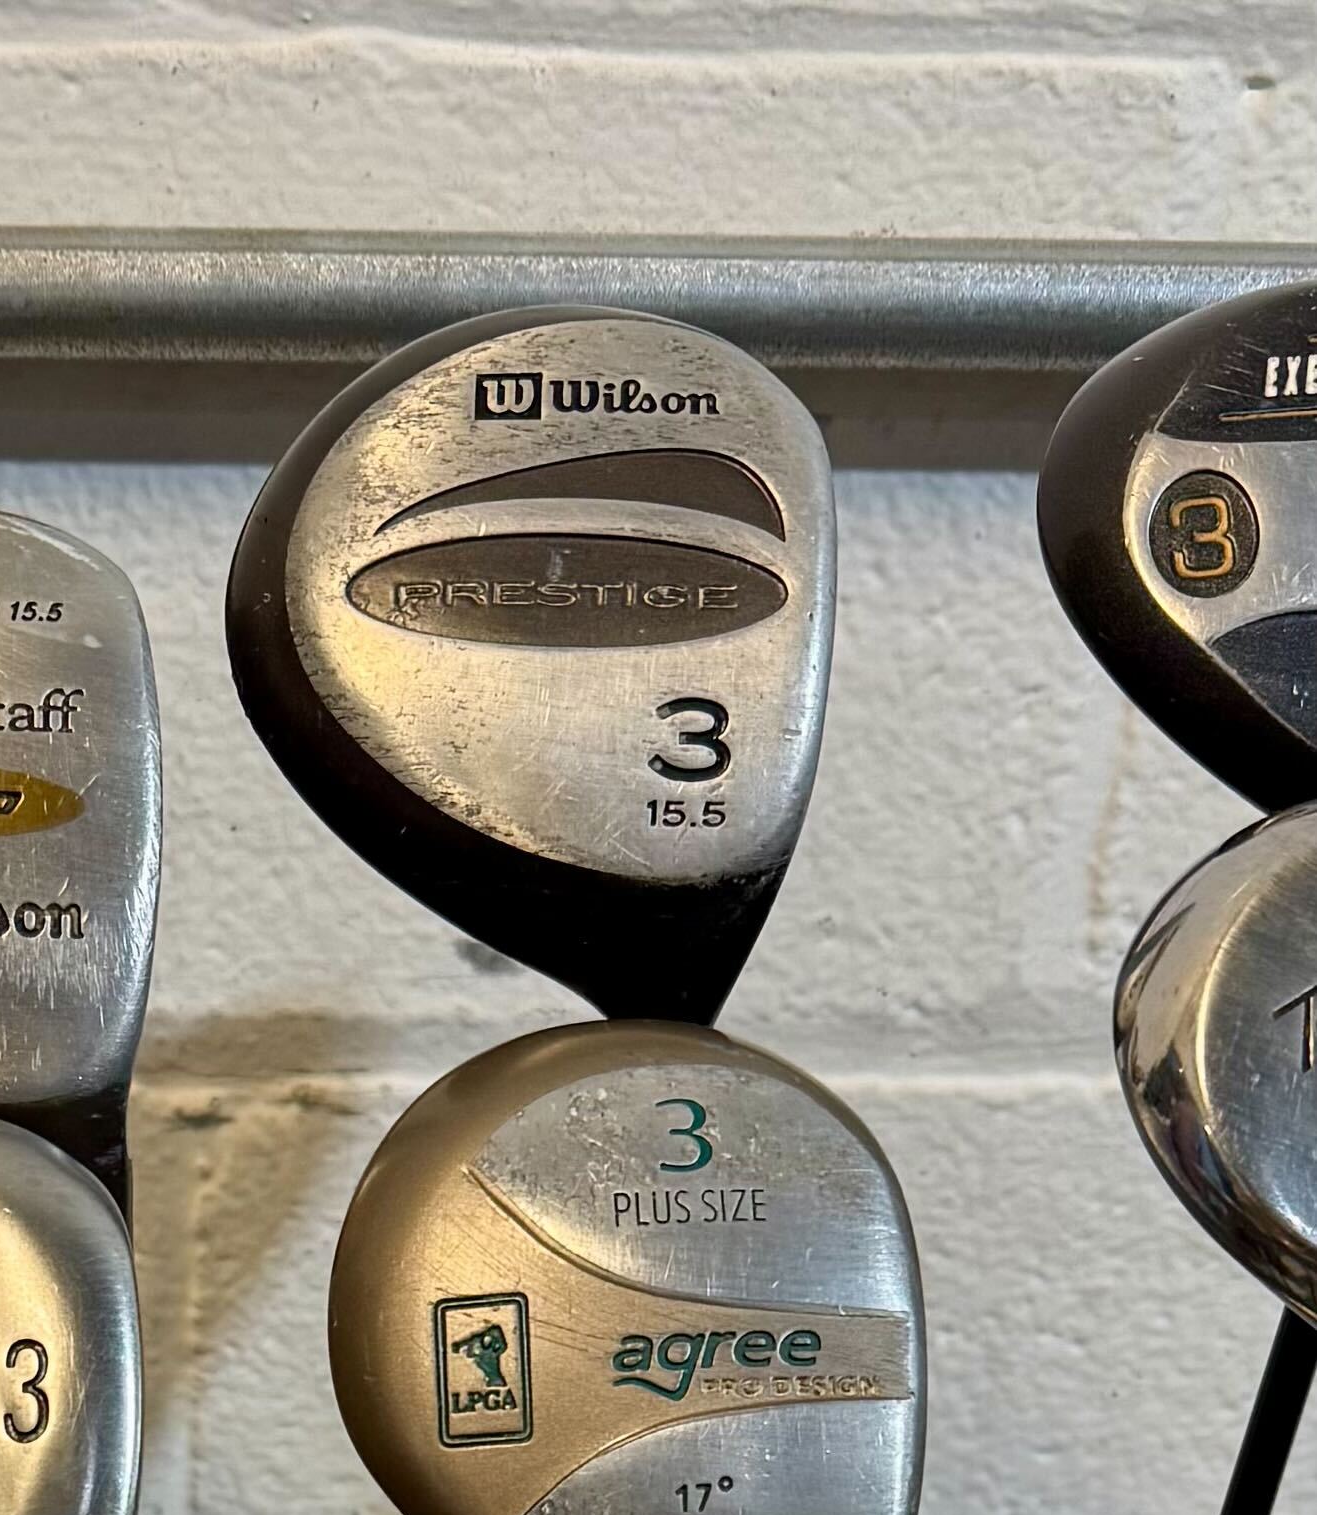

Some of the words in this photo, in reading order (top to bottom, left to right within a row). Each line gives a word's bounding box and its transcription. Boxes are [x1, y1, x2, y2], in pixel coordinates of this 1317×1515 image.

[549, 379, 720, 416] Wilson
[1169, 495, 1235, 579] 3
[9, 601, 63, 623] 15.5
[394, 580, 739, 609] PRESTIGE
[647, 697, 731, 783] 3
[646, 800, 728, 829] 15.5
[655, 1097, 713, 1174] 3
[613, 1191, 691, 1227] PLUS
[703, 1188, 767, 1224] SIZE
[611, 1328, 822, 1401] agree
[3, 1338, 51, 1444] 3
[451, 1390, 518, 1415] LPGA
[701, 1376, 764, 1397] PRO
[769, 1374, 881, 1397] DESIGN
[675, 1474, 735, 1514] 17°
